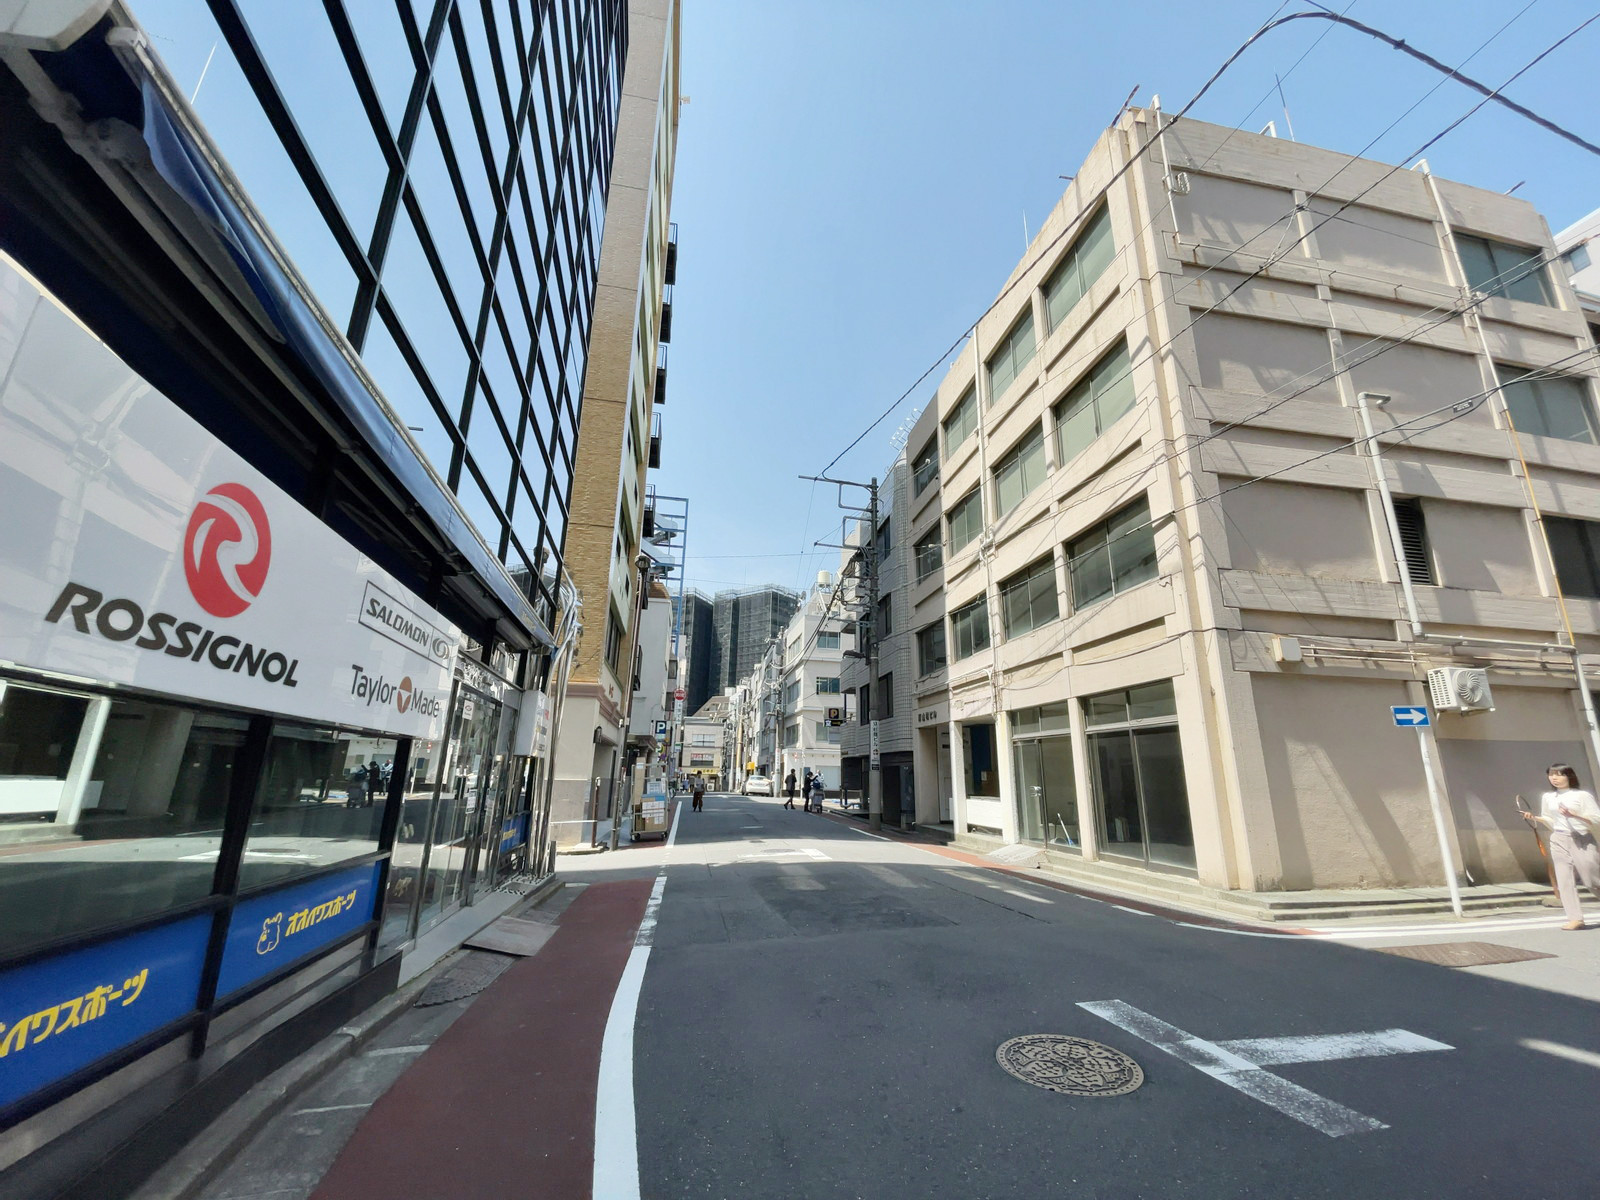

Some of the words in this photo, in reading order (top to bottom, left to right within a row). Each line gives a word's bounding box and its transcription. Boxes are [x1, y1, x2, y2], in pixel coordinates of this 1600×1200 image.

[45, 582, 299, 688] ROSSIGNOL
[366, 598, 429, 647] SALOMON
[351, 664, 397, 706] Taylor
[410, 688, 440, 718] Made
[656, 722, 666, 733] P
[285, 889, 357, 937] オオイワスポーツ
[0, 968, 149, 1058] イワスポーツ
